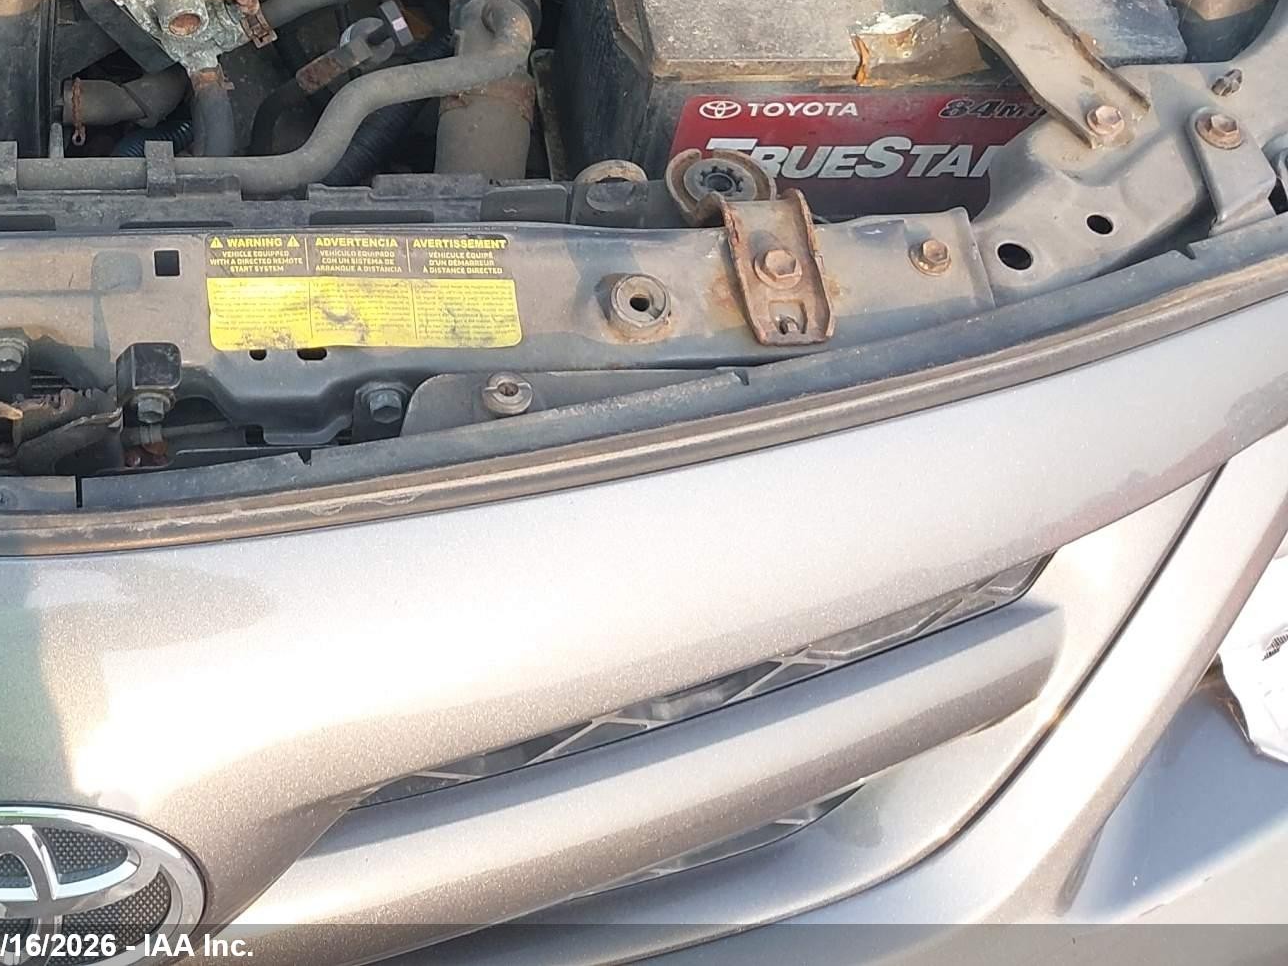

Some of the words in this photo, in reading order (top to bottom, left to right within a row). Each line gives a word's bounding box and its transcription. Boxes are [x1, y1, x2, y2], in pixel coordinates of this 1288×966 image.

[747, 101, 859, 117] TOYOTA
[226, 237, 283, 248] WARNING
[315, 237, 398, 248] ADVERTENCIA
[413, 238, 508, 249] AVERTISSEMENT
[222, 250, 253, 258] VEHICLE
[357, 250, 395, 258] EQUIPADO
[209, 258, 230, 266] WITH
[273, 257, 303, 265] REMOTE
[384, 258, 394, 266] DE
[430, 266, 466, 274] DISTANCE
[466, 267, 503, 275] DIRECTED
